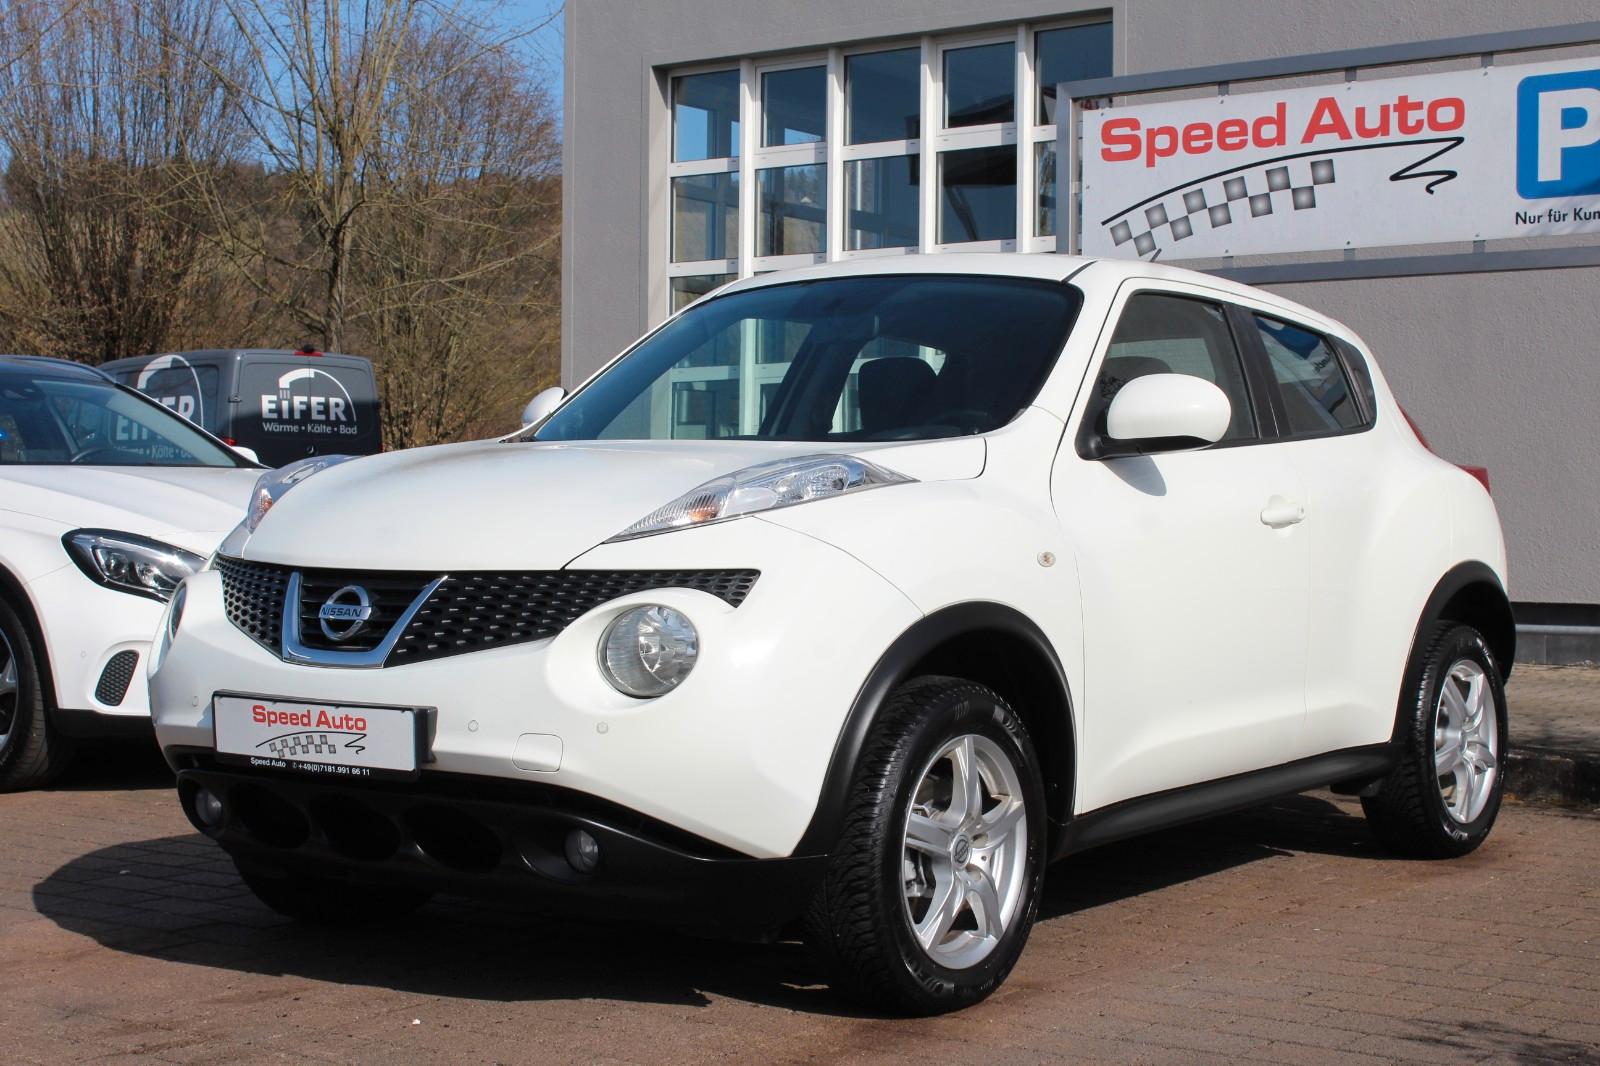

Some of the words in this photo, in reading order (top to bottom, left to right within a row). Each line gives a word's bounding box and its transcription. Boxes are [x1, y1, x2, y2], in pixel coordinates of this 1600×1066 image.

[1100, 102, 1287, 169] Speed
[1300, 95, 1466, 144] Auto
[1515, 211, 1543, 225] Nur
[1548, 208, 1568, 223] für
[262, 422, 299, 432] Wärme
[307, 423, 332, 433] Kälte
[339, 424, 357, 434] Bad
[321, 607, 362, 617] NISSAN
[252, 704, 311, 727] Speed
[316, 710, 367, 731] Auto
[250, 757, 270, 766] Speed
[271, 759, 286, 768] Auto
[362, 768, 370, 776] 11
